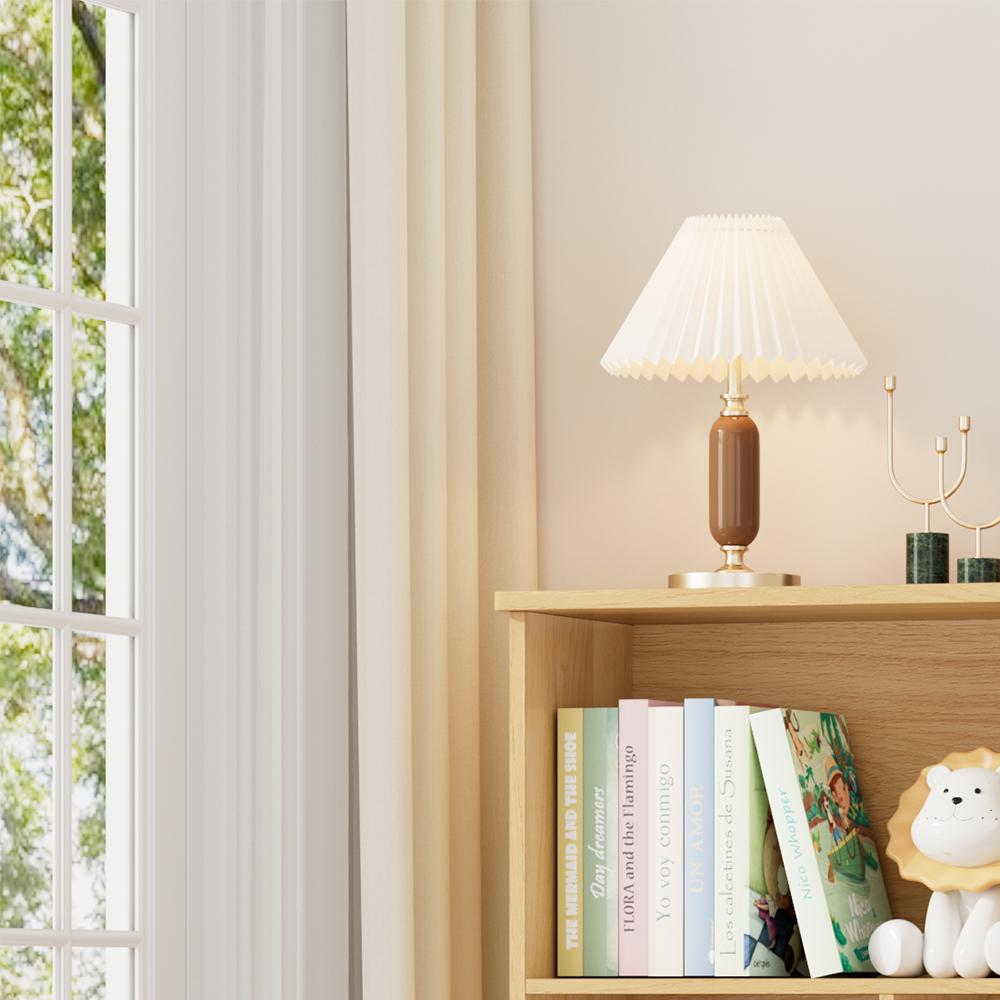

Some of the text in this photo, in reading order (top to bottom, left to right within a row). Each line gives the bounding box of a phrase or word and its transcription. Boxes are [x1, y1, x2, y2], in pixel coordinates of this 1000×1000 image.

[563, 731, 579, 950] THE MERMAID AND THE SHOE
[587, 786, 611, 899] Day dreamers
[622, 745, 637, 932] FLORA and the Flamingo
[656, 763, 674, 922] Yo voy conmigo
[687, 784, 704, 894] UN AMOR
[718, 728, 736, 955] Los calcetines de Susana
[777, 787, 812, 900] Nico Whopper
